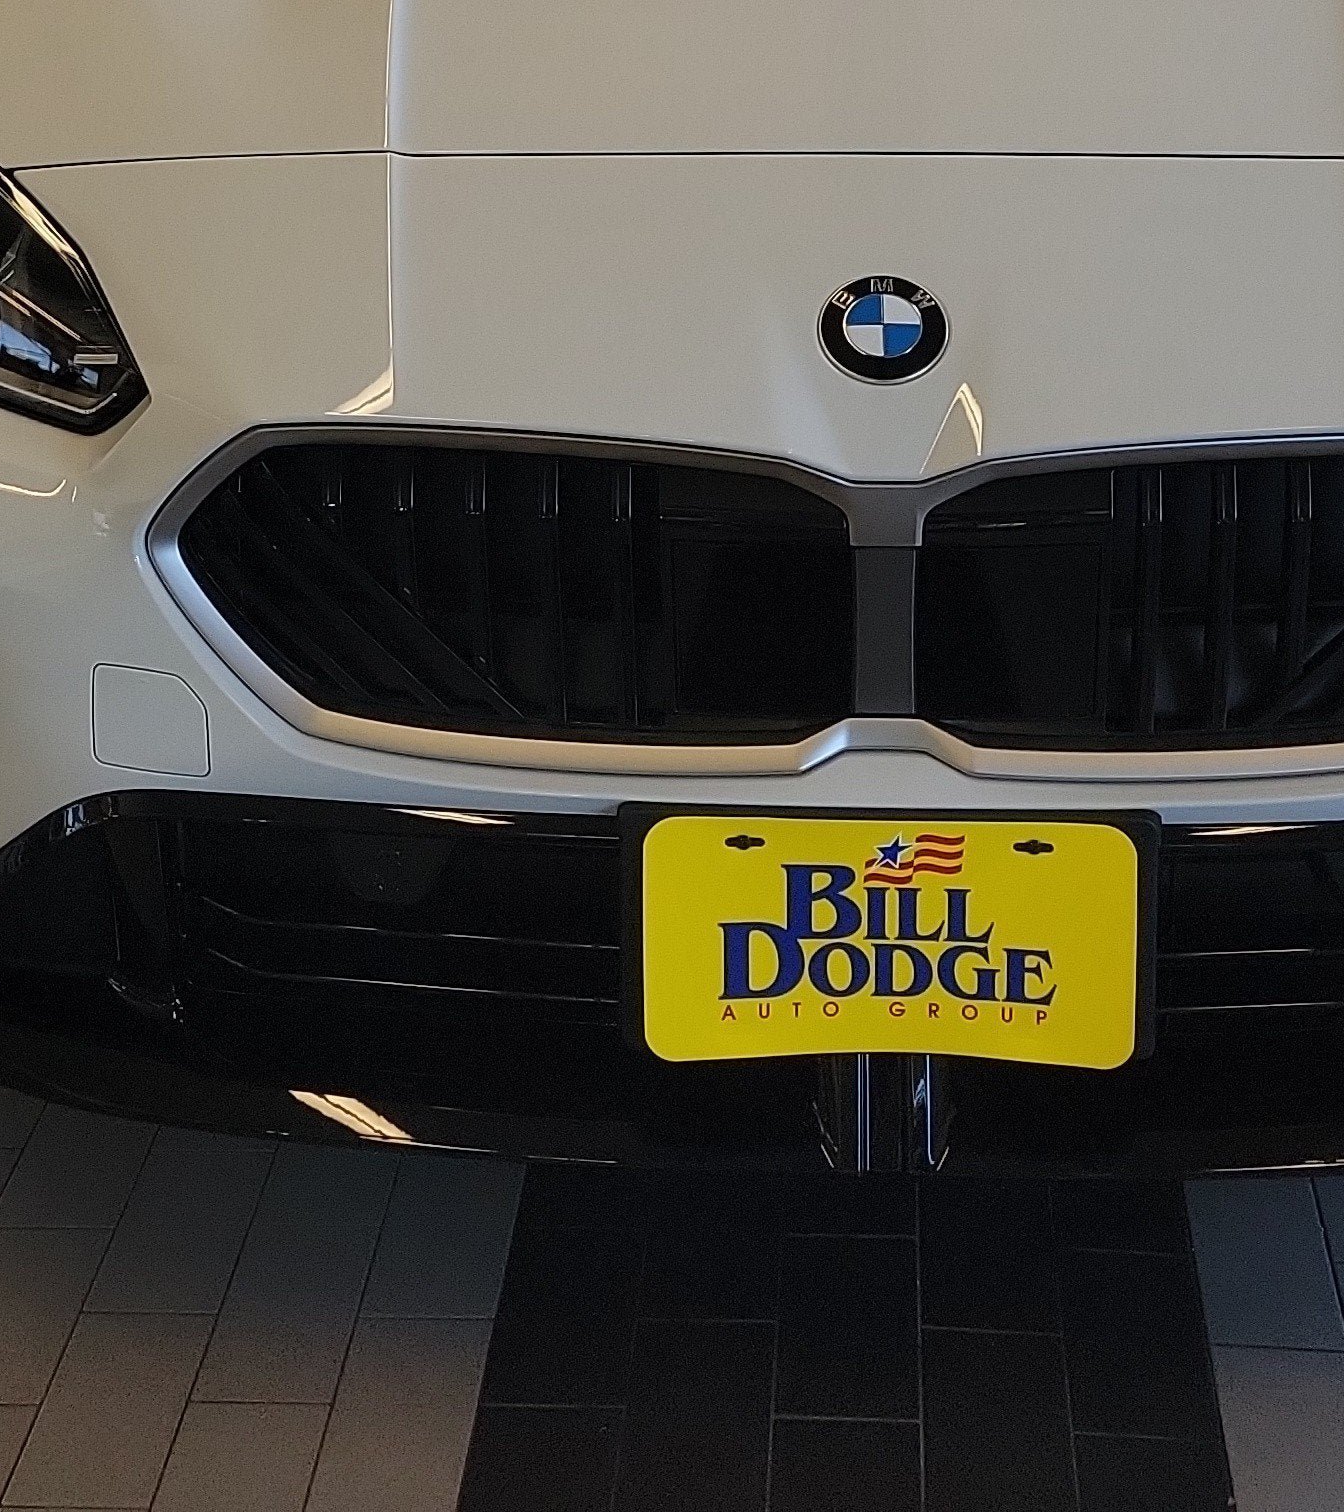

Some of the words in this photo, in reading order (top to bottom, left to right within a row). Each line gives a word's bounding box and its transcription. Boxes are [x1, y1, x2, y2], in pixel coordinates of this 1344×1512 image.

[831, 278, 936, 309] BMW
[780, 863, 995, 944] BILL
[717, 921, 1058, 1007] DODGE
[721, 1001, 840, 1021] AUTO
[888, 1001, 1048, 1026] GROUP
